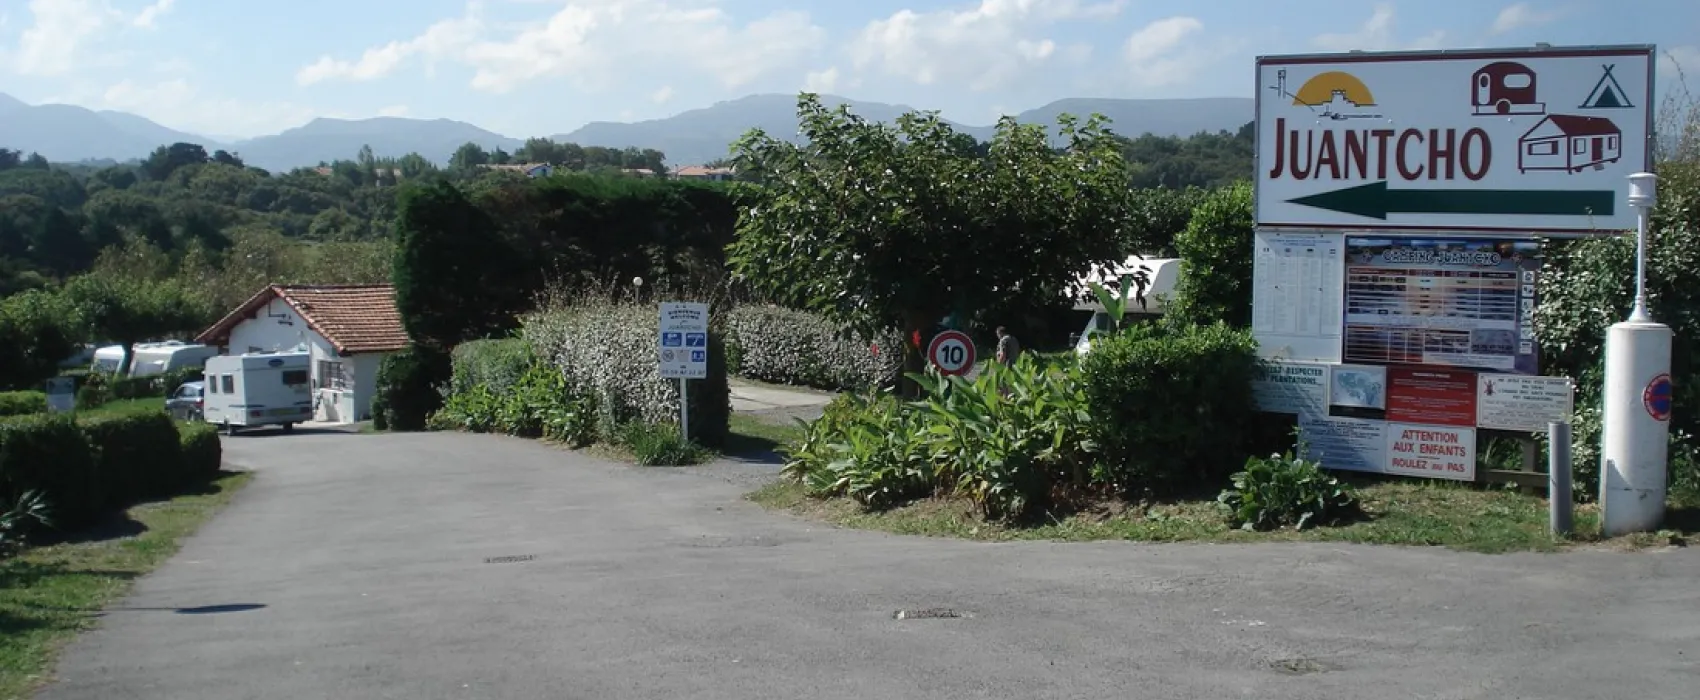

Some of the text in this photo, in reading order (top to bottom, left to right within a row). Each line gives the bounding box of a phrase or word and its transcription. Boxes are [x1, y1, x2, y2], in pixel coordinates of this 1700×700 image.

[1270, 118, 1492, 181] JUANTCHO
[941, 344, 963, 365] 10
[1401, 429, 1458, 443] ATTENTION
[1393, 441, 1466, 457] AUX ENFANTS
[1392, 457, 1428, 469] ROULEZ
[1447, 462, 1465, 472] PAS
